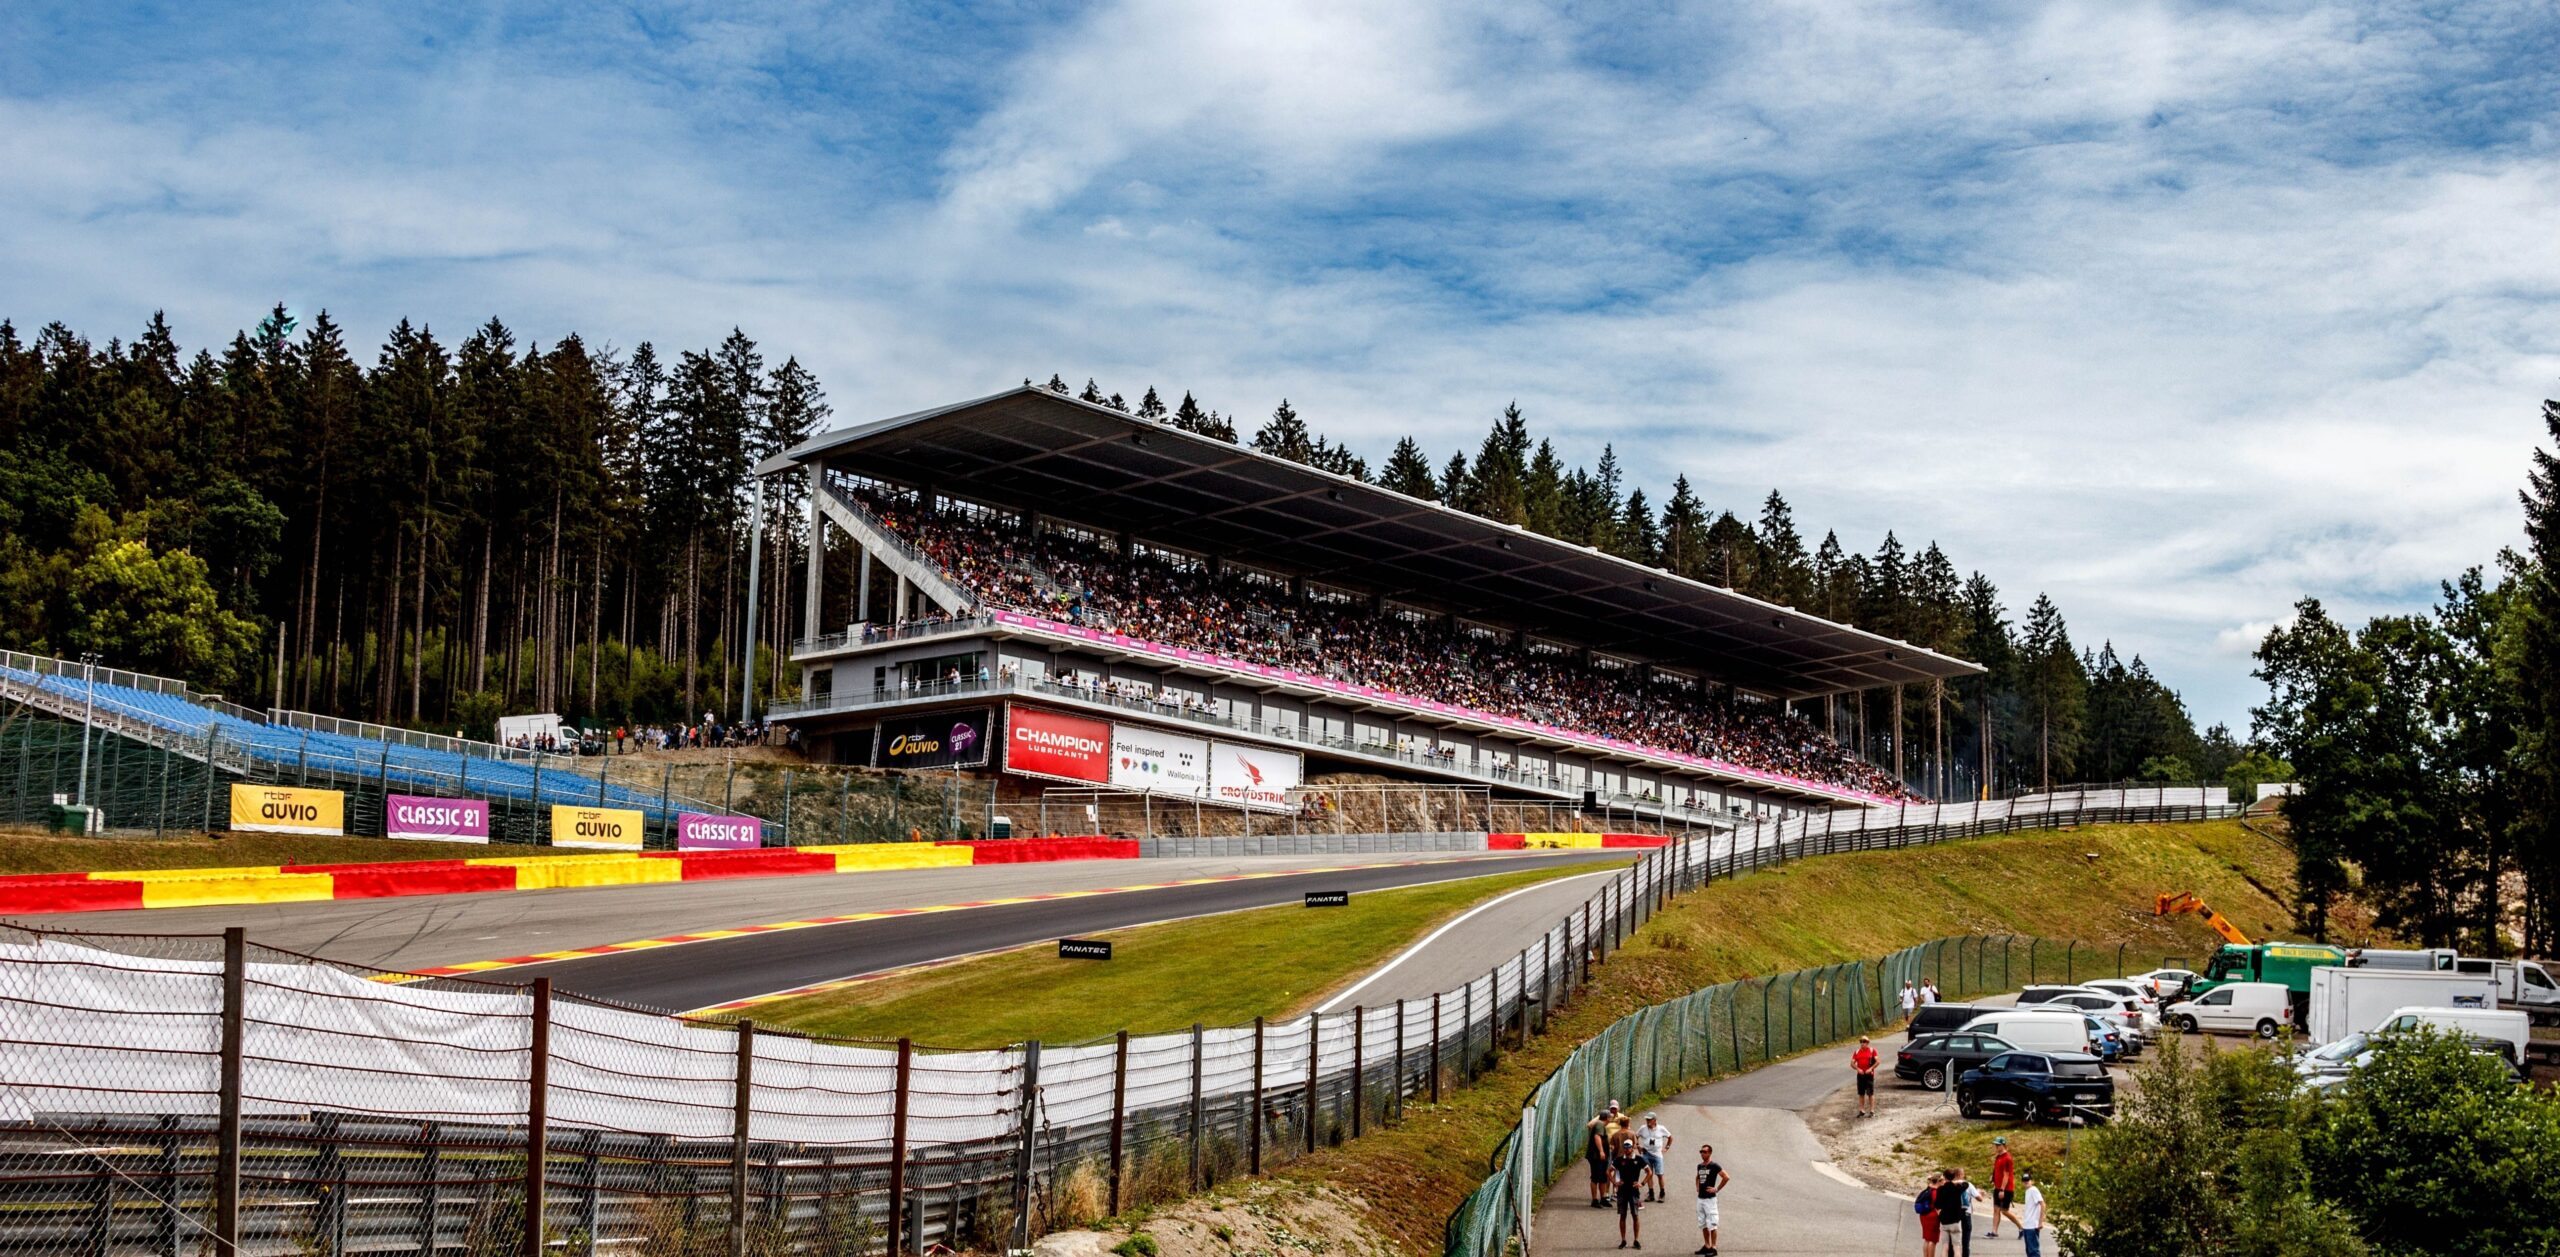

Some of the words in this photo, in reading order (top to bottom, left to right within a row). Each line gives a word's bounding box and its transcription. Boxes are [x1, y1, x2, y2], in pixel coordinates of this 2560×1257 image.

[951, 730, 972, 743] CLASSIC
[1016, 727, 1102, 753] CHAMPION
[905, 740, 939, 754] auvio
[954, 741, 962, 751] 21
[1028, 744, 1088, 760] LUBRICANTS
[1116, 742, 1132, 752] Feel
[1135, 745, 1164, 758] inspired
[1220, 786, 1285, 803] CROWDSTRIK
[262, 803, 318, 821] auvio
[398, 806, 460, 826] CLASSIC
[464, 809, 479, 827] 21
[576, 821, 622, 837] auvio
[687, 823, 738, 841] CLASSIC
[741, 825, 754, 842] 21
[1061, 945, 1106, 954] FANATEC
